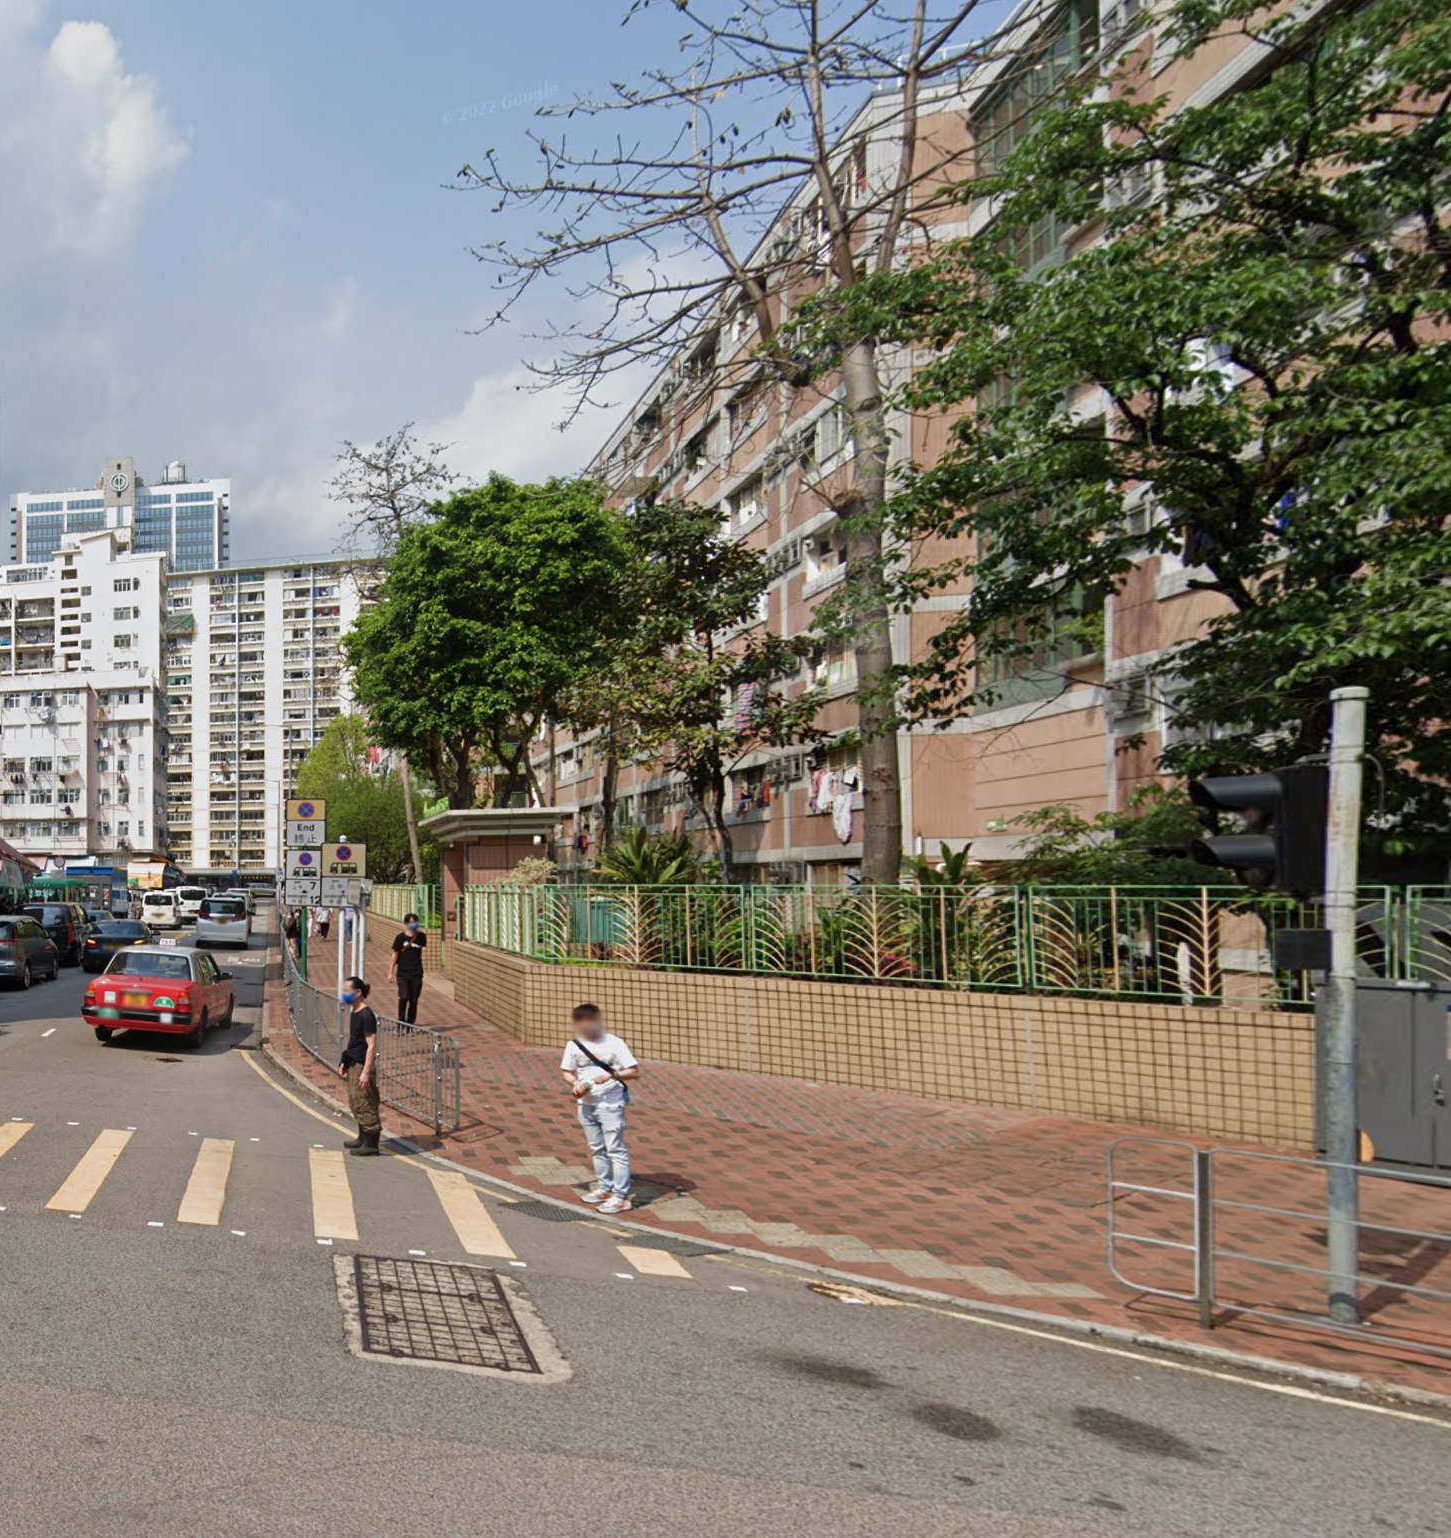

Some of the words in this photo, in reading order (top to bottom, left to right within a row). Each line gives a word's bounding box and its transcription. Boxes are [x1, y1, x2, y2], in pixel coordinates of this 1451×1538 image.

[297, 823, 315, 832] End
[294, 834, 317, 844] 終止
[309, 881, 316, 890] 7
[309, 895, 320, 905] 12
